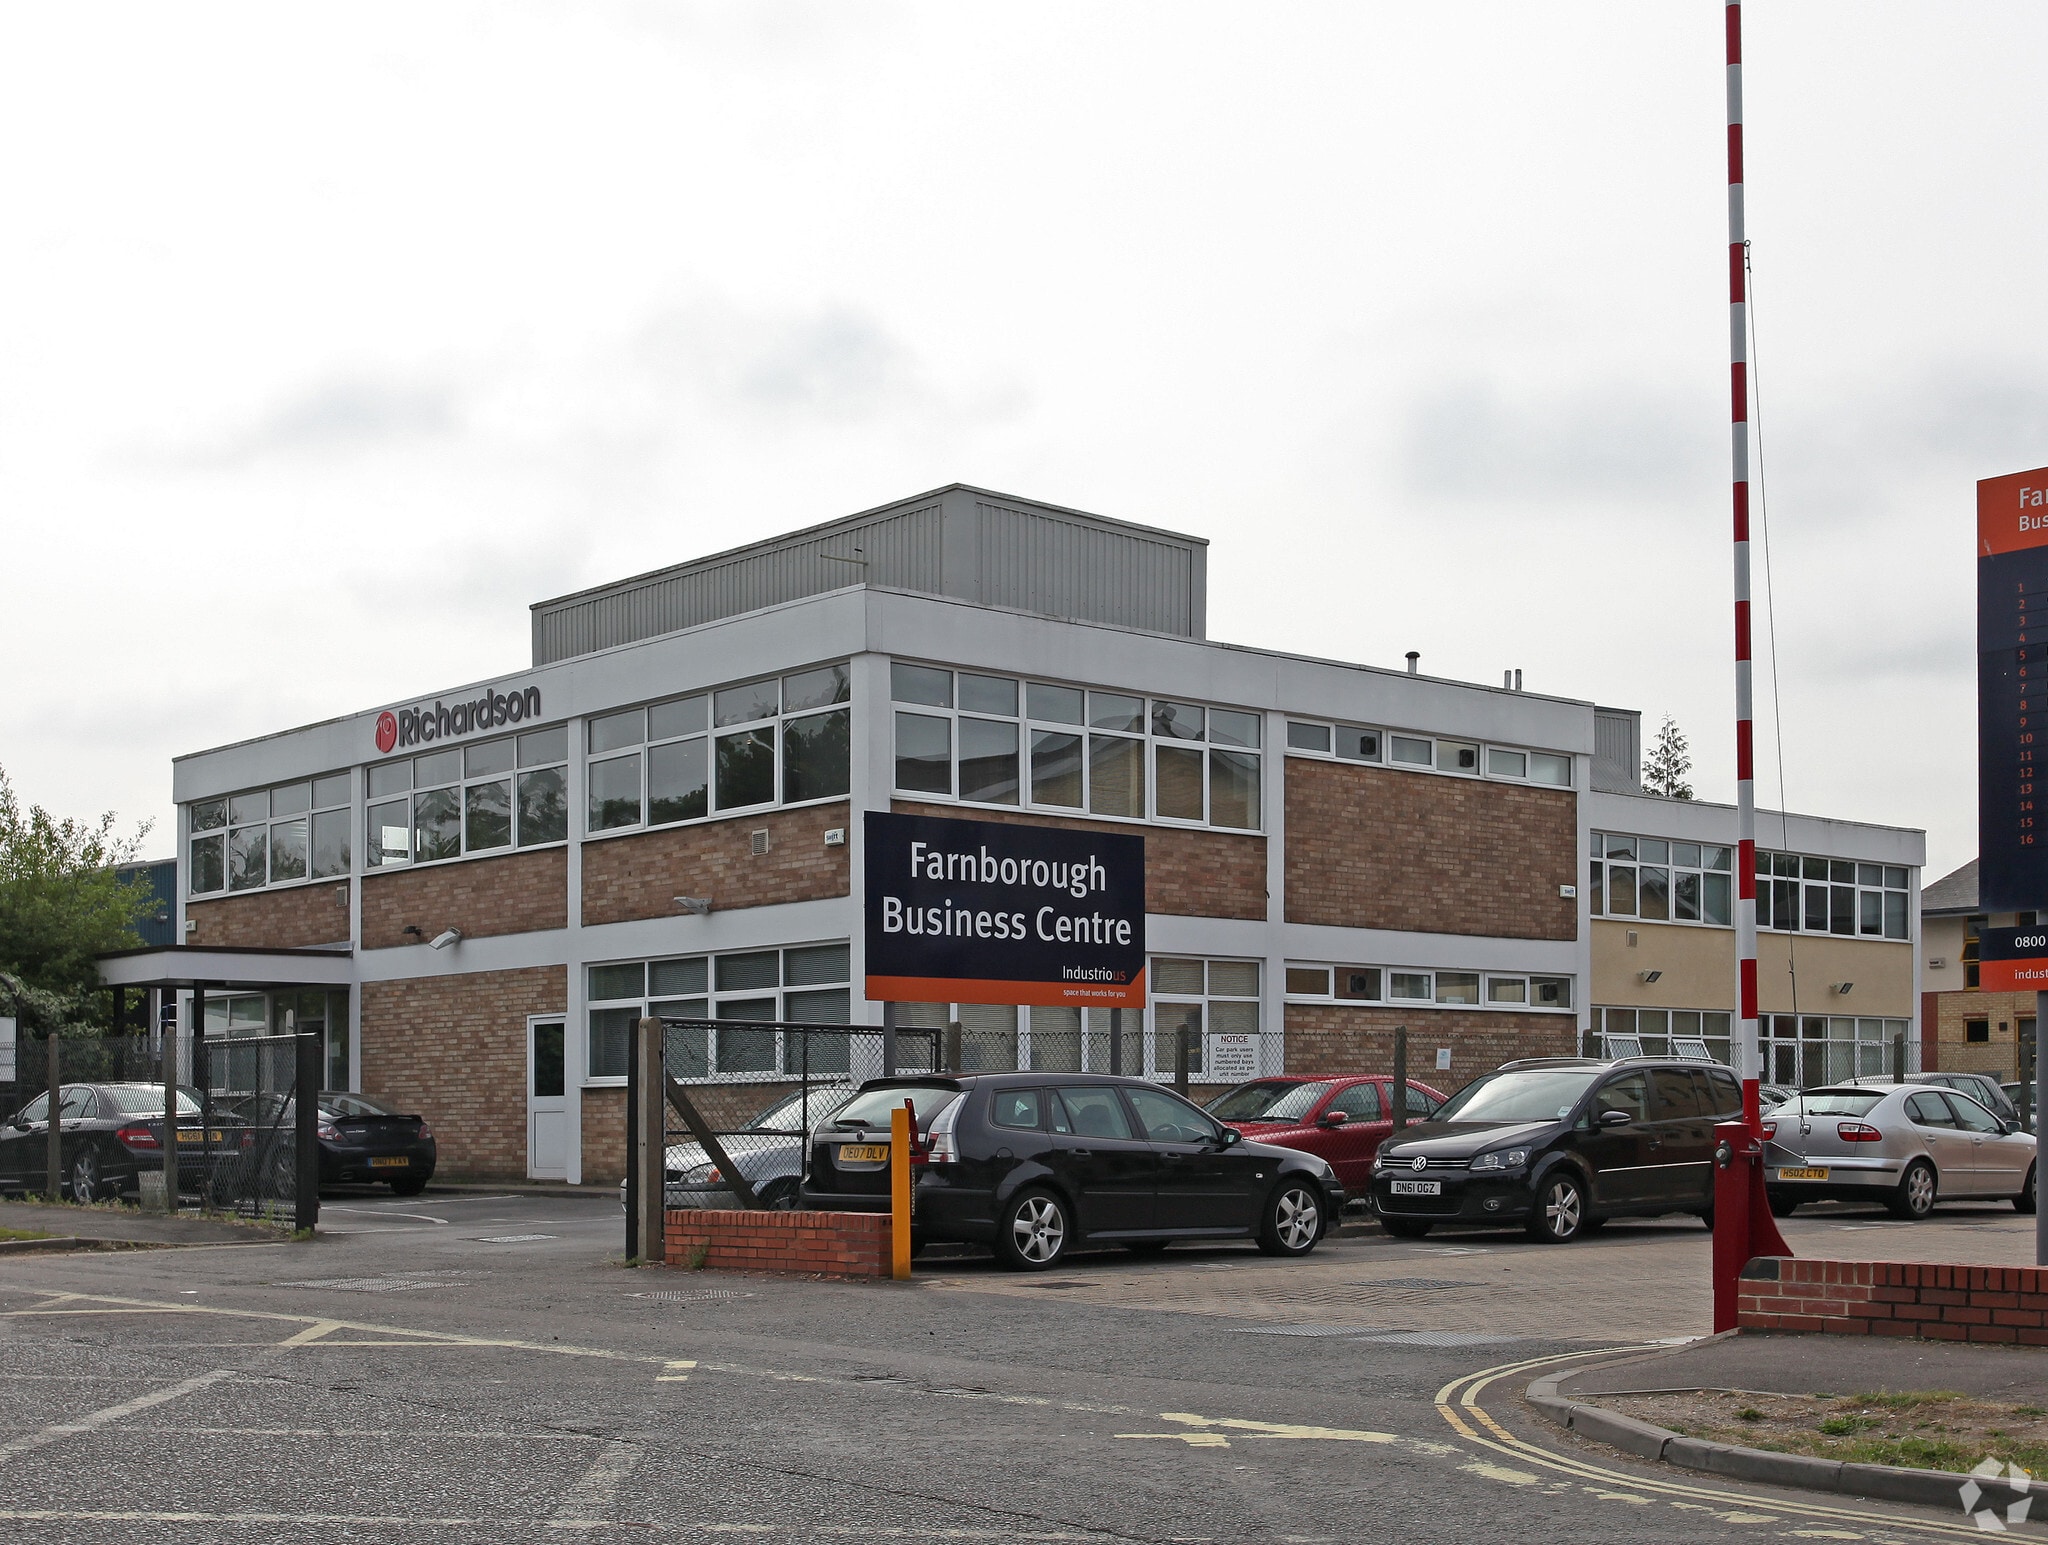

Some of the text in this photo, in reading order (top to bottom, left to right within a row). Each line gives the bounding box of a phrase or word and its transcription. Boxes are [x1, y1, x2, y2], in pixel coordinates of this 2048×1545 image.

[2018, 583, 2024, 592] 1
[2018, 600, 2025, 609] 2
[2019, 616, 2026, 626] 3
[2019, 633, 2026, 642] 4
[2019, 650, 2025, 660] 5
[2019, 667, 2026, 676] 6
[2020, 684, 2027, 694] 7
[2020, 700, 2026, 710] 8
[398, 685, 541, 747] Richardson
[2020, 718, 2026, 727] 9
[2020, 734, 2032, 744] 10
[2020, 751, 2032, 761] 11
[2020, 768, 2032, 778] 12
[2020, 784, 2032, 794] 13
[2020, 801, 2033, 811] 14
[2020, 818, 2033, 828] 15
[2020, 834, 2033, 844] 16
[910, 841, 1106, 898] Farnborough
[882, 896, 1132, 946] Business Centre
[2015, 935, 2046, 948] 0800
[1062, 966, 1126, 982] Industrious
[1063, 990, 1079, 998] space
[1080, 989, 1091, 997] that
[1092, 990, 1108, 998] works
[1108, 990, 1116, 998] for
[1221, 1035, 1248, 1043] NOTICE
[866, 1148, 884, 1159] DLV
[1783, 1169, 1804, 1178] HS02
[1396, 1182, 1415, 1193] DN61
